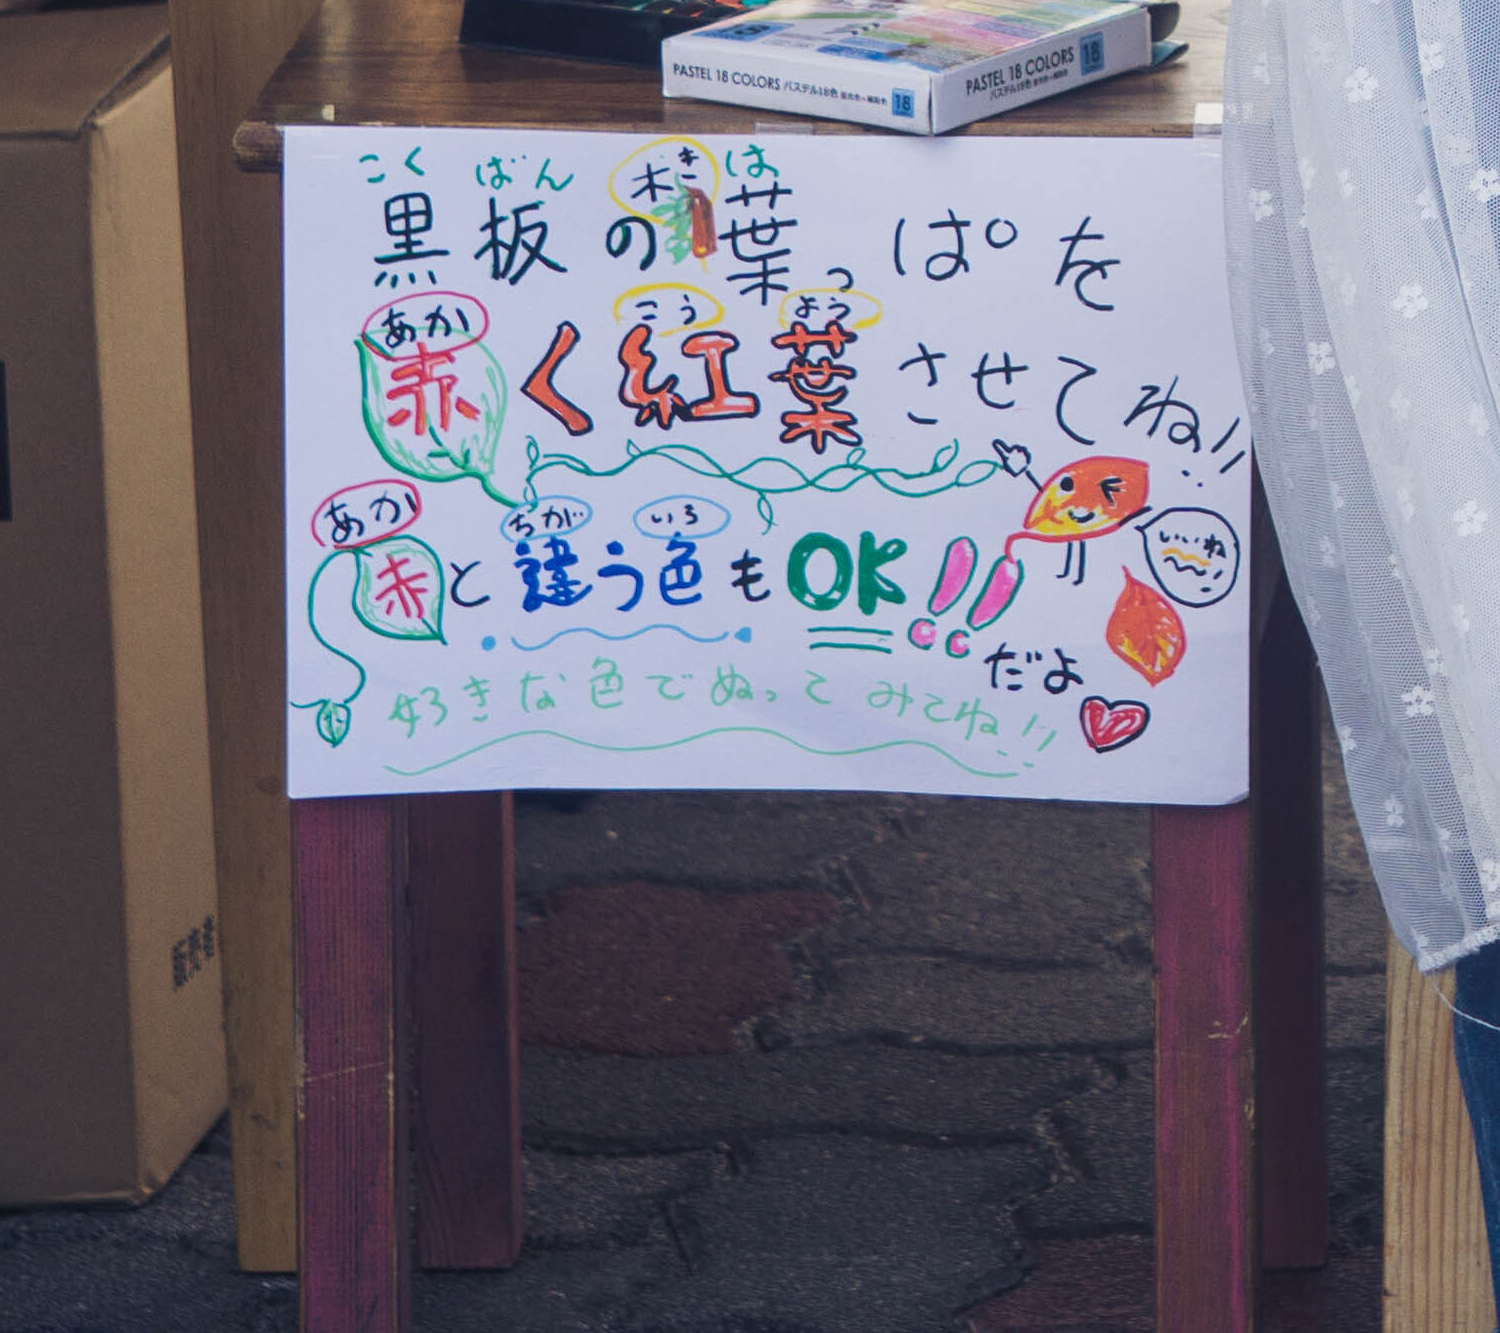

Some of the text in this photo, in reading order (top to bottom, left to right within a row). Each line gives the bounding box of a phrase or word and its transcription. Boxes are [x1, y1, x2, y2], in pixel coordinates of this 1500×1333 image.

[672, 62, 713, 82] PASTEL
[715, 69, 729, 83] 18
[731, 71, 781, 92] COLORS
[895, 93, 912, 111] 18
[965, 68, 1007, 97] PASTEL
[1008, 63, 1023, 82] 18
[1025, 46, 1076, 76] COLORS
[1084, 40, 1101, 66] 18
[358, 146, 426, 184] こく
[475, 155, 575, 192] ばん
[724, 143, 780, 181] は
[381, 294, 852, 349] あか こう よう
[323, 491, 700, 544] あか ちが いろ
